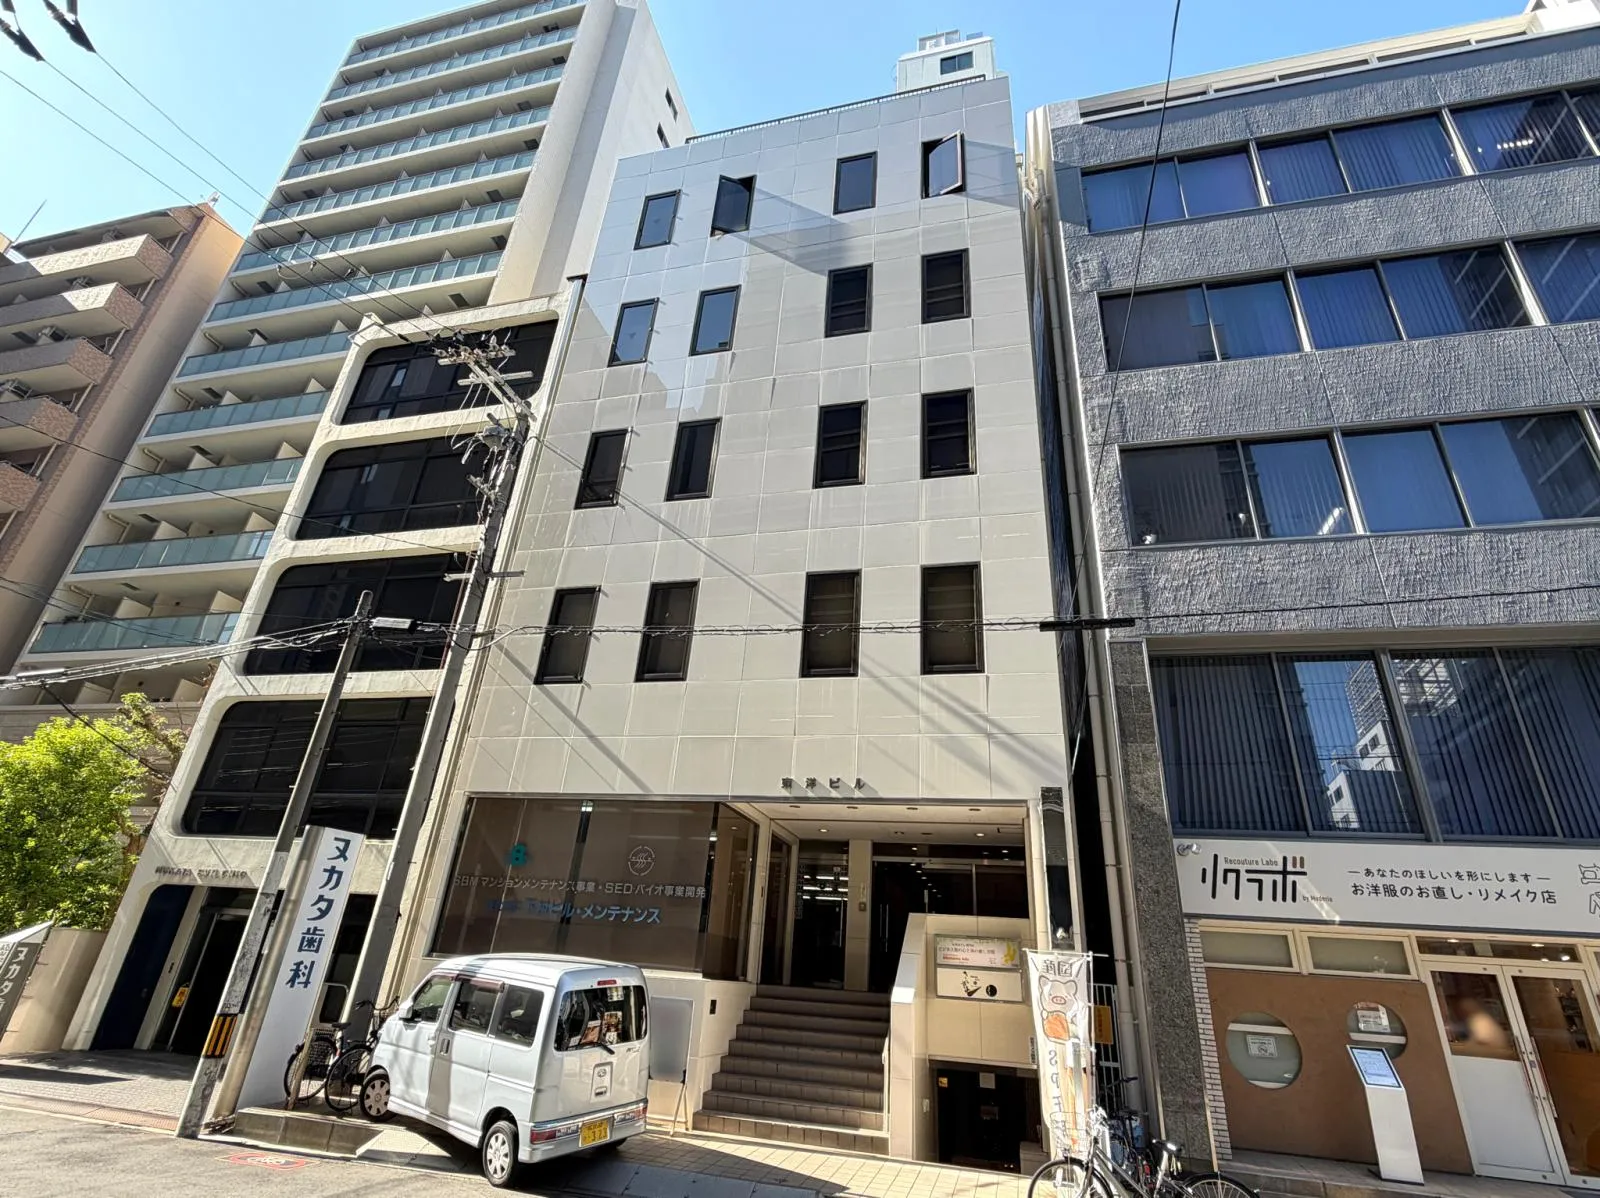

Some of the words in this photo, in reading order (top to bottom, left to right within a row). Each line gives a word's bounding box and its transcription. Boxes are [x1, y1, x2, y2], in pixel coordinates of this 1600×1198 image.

[1223, 857, 1260, 867] Recouture
[1261, 858, 1279, 868] Labo
[1351, 883, 1558, 904] お洋服のお直し・リメイク店
[285, 837, 351, 989] ヌカタ歯科
